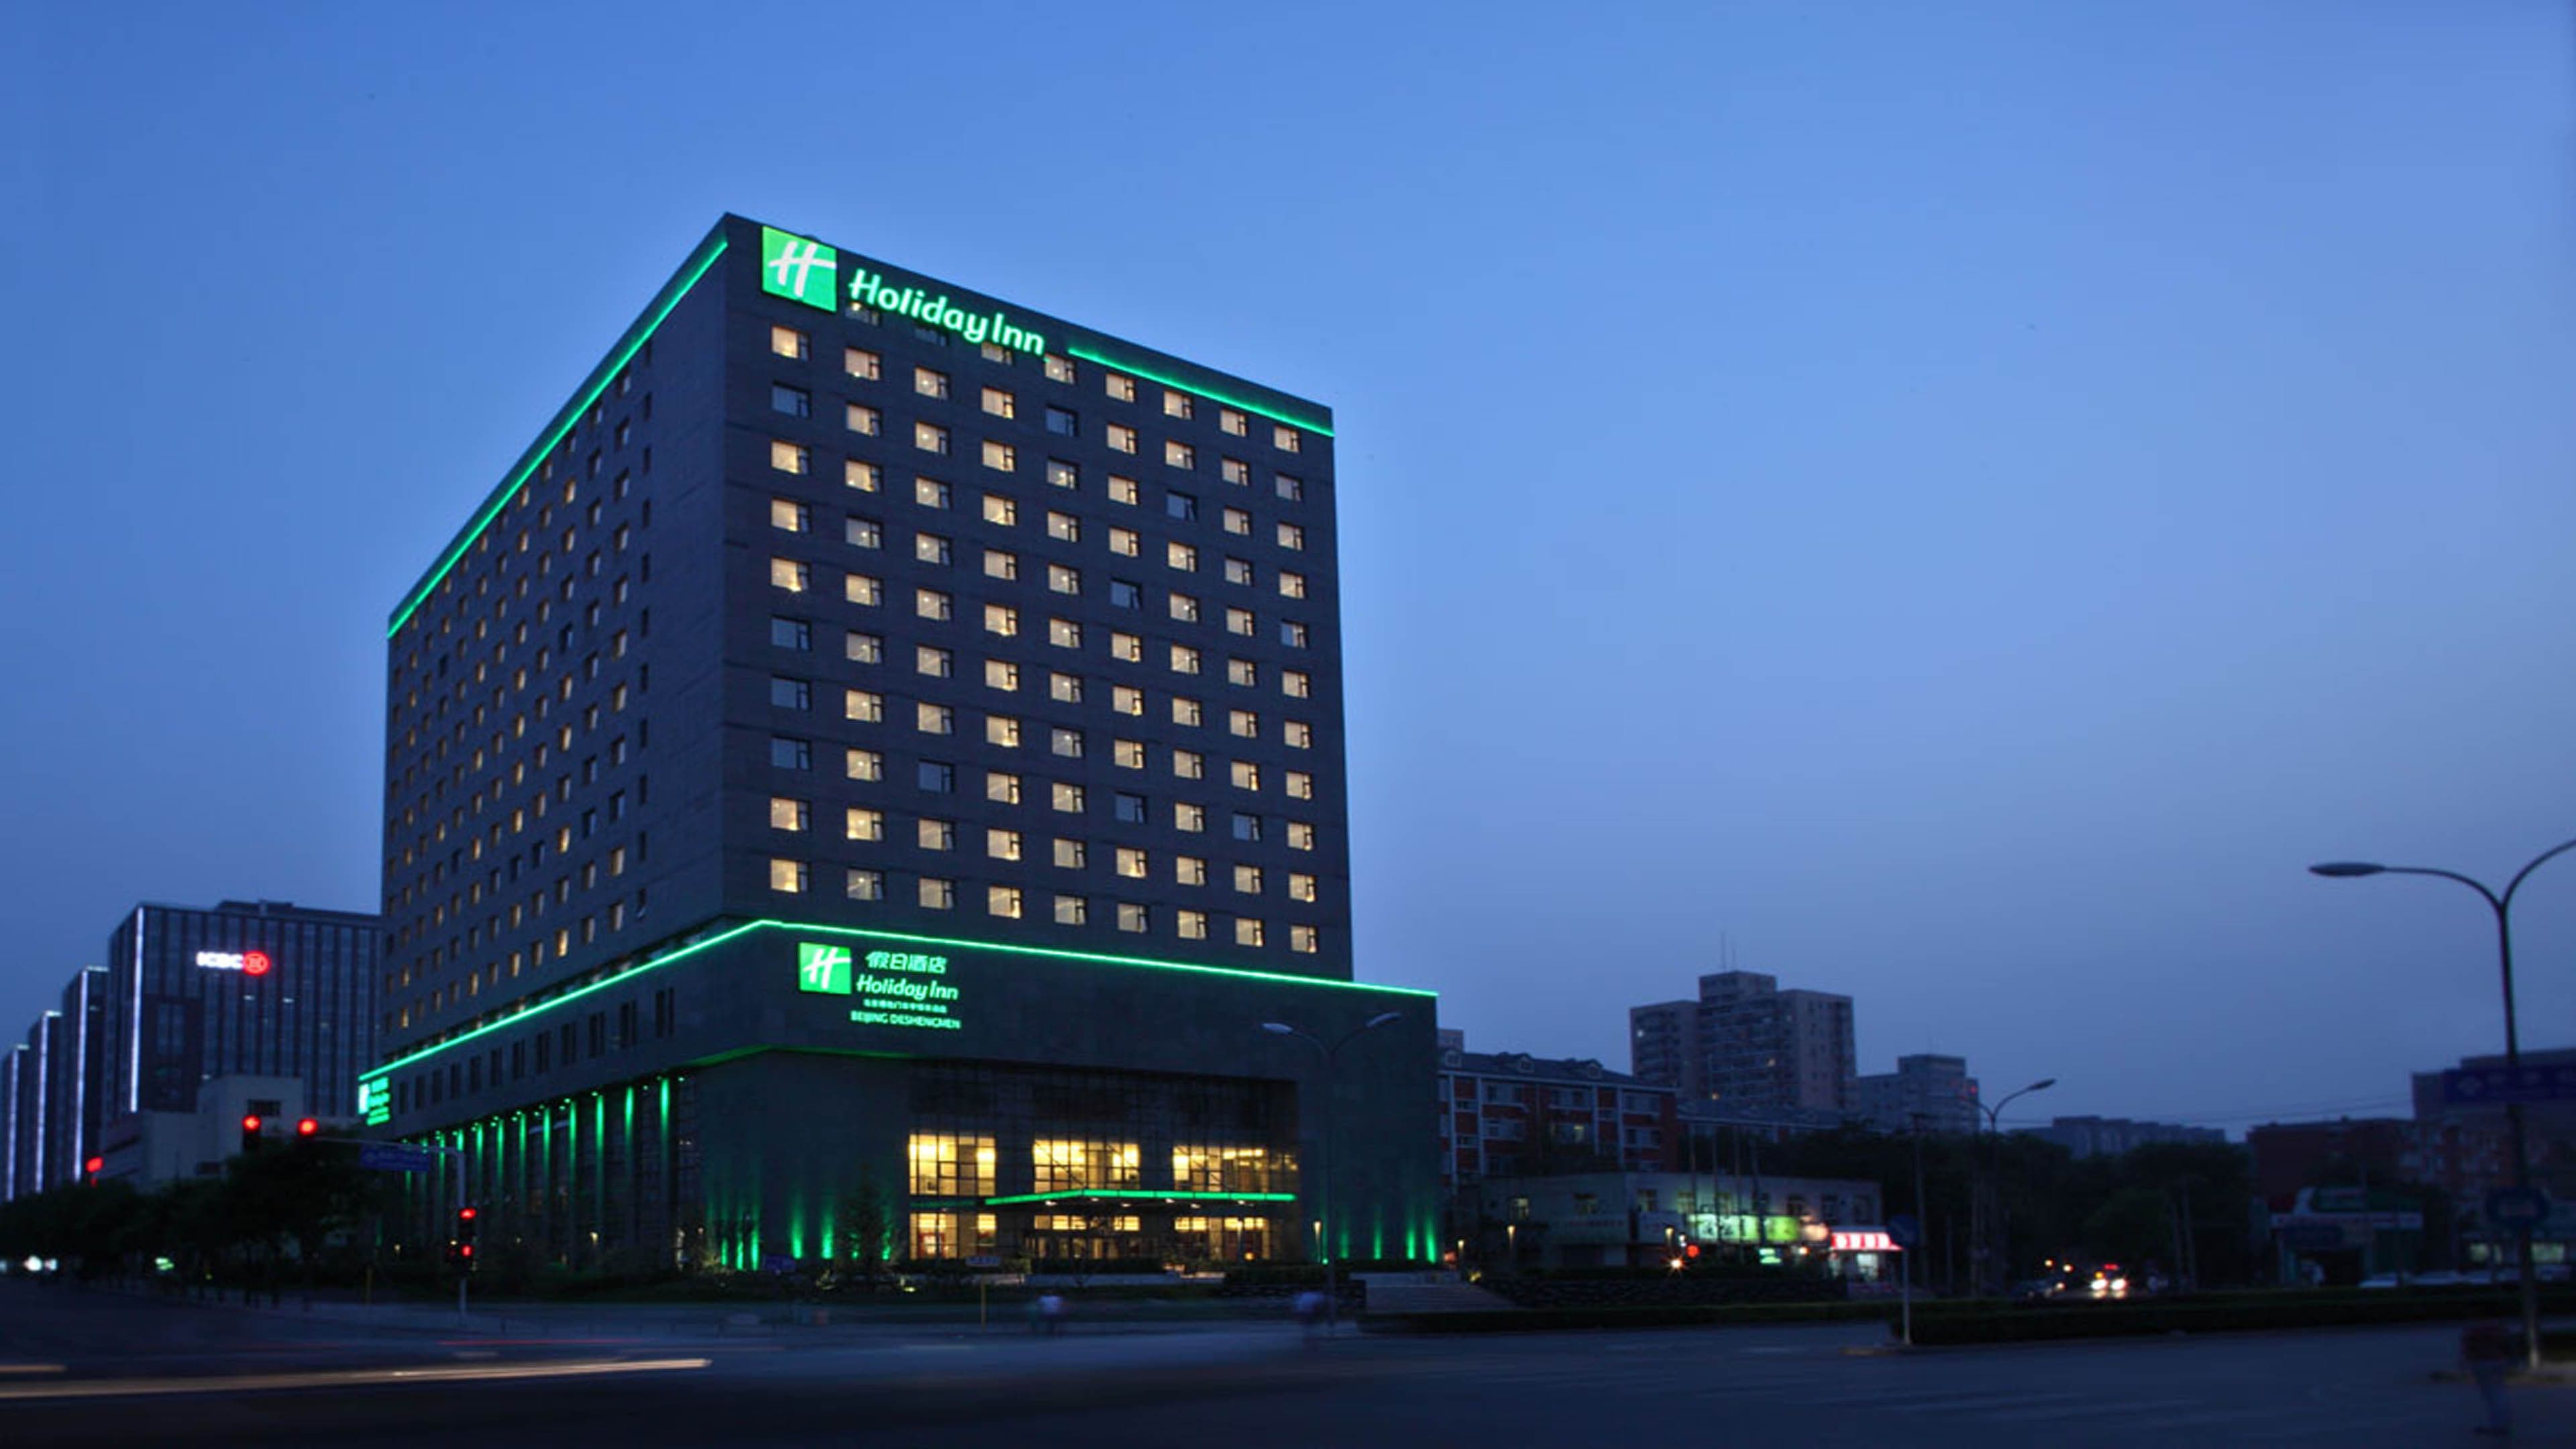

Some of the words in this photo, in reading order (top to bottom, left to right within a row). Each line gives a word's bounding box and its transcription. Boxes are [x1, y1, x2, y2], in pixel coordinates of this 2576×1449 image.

[849, 268, 988, 344] Holiday
[993, 312, 1045, 356] Inn
[865, 951, 948, 974] 假日酒店
[856, 973, 928, 1001] Holiday
[929, 980, 959, 1000] Inn
[850, 1010, 889, 1025] BEIJING
